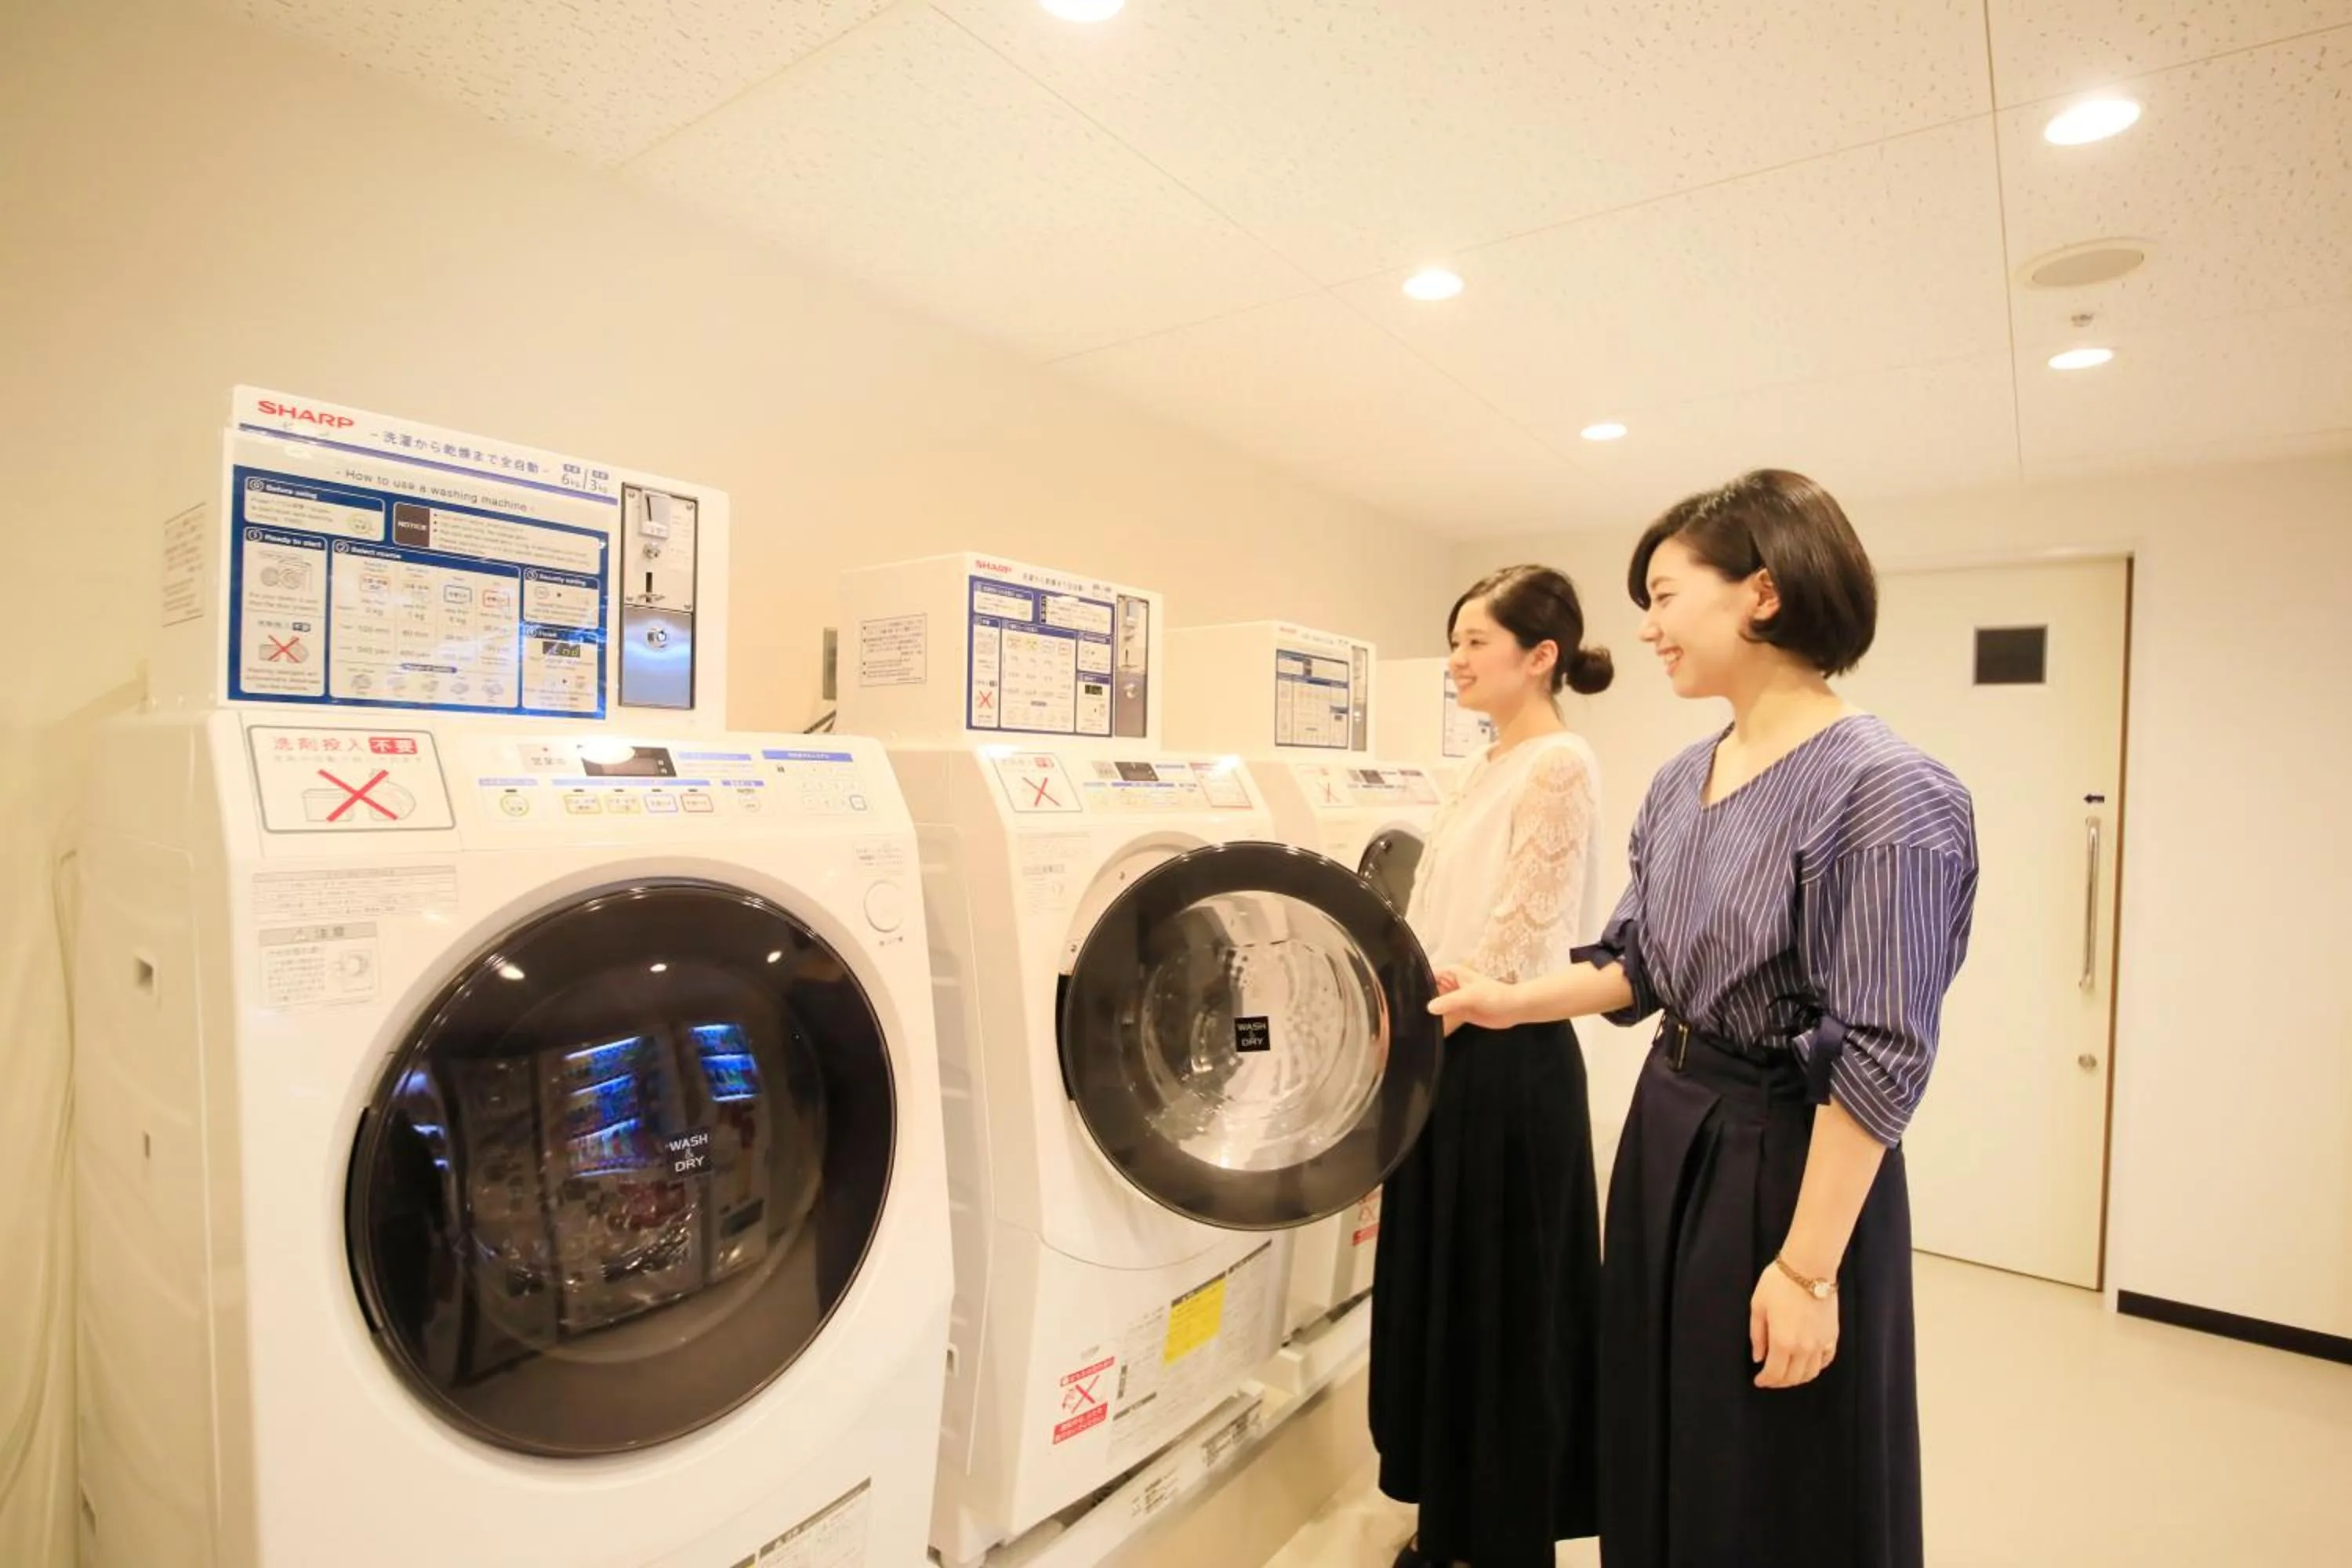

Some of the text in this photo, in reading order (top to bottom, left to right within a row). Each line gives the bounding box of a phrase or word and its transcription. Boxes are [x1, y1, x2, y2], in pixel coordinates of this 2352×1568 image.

[258, 401, 354, 428] SHARP
[345, 469, 528, 513] How to use a washing machine
[1237, 1022, 1267, 1032] WASH
[1241, 1036, 1264, 1047] DRY
[668, 1133, 709, 1152] WASH
[684, 1148, 694, 1158] &
[674, 1155, 705, 1173] DRY
